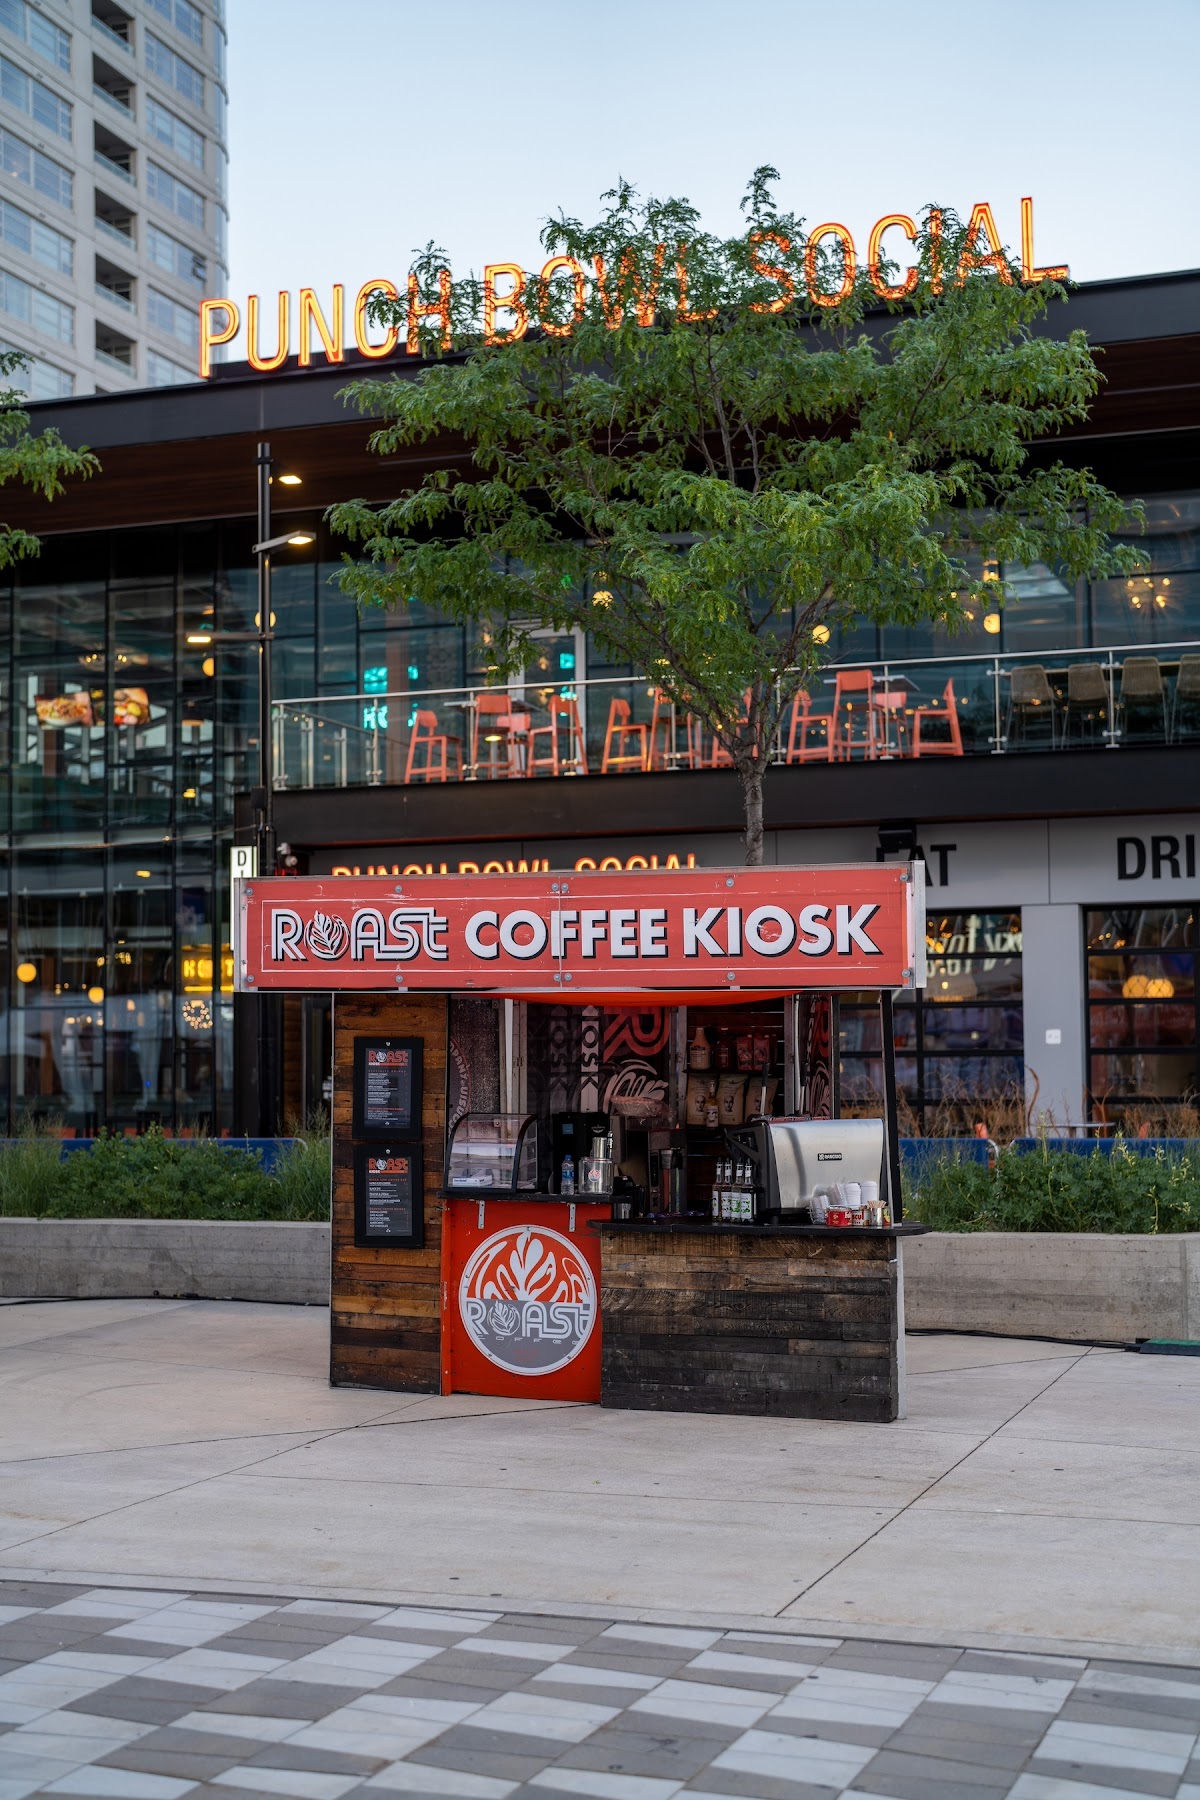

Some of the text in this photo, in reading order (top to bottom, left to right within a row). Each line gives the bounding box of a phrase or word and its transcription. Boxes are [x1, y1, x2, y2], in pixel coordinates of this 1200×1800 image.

[200, 196, 1069, 379] PUNCH BOWL SOCIAL
[1117, 835, 1197, 881] DRI
[465, 908, 669, 960] COFFEE
[683, 904, 884, 958] KIOSK
